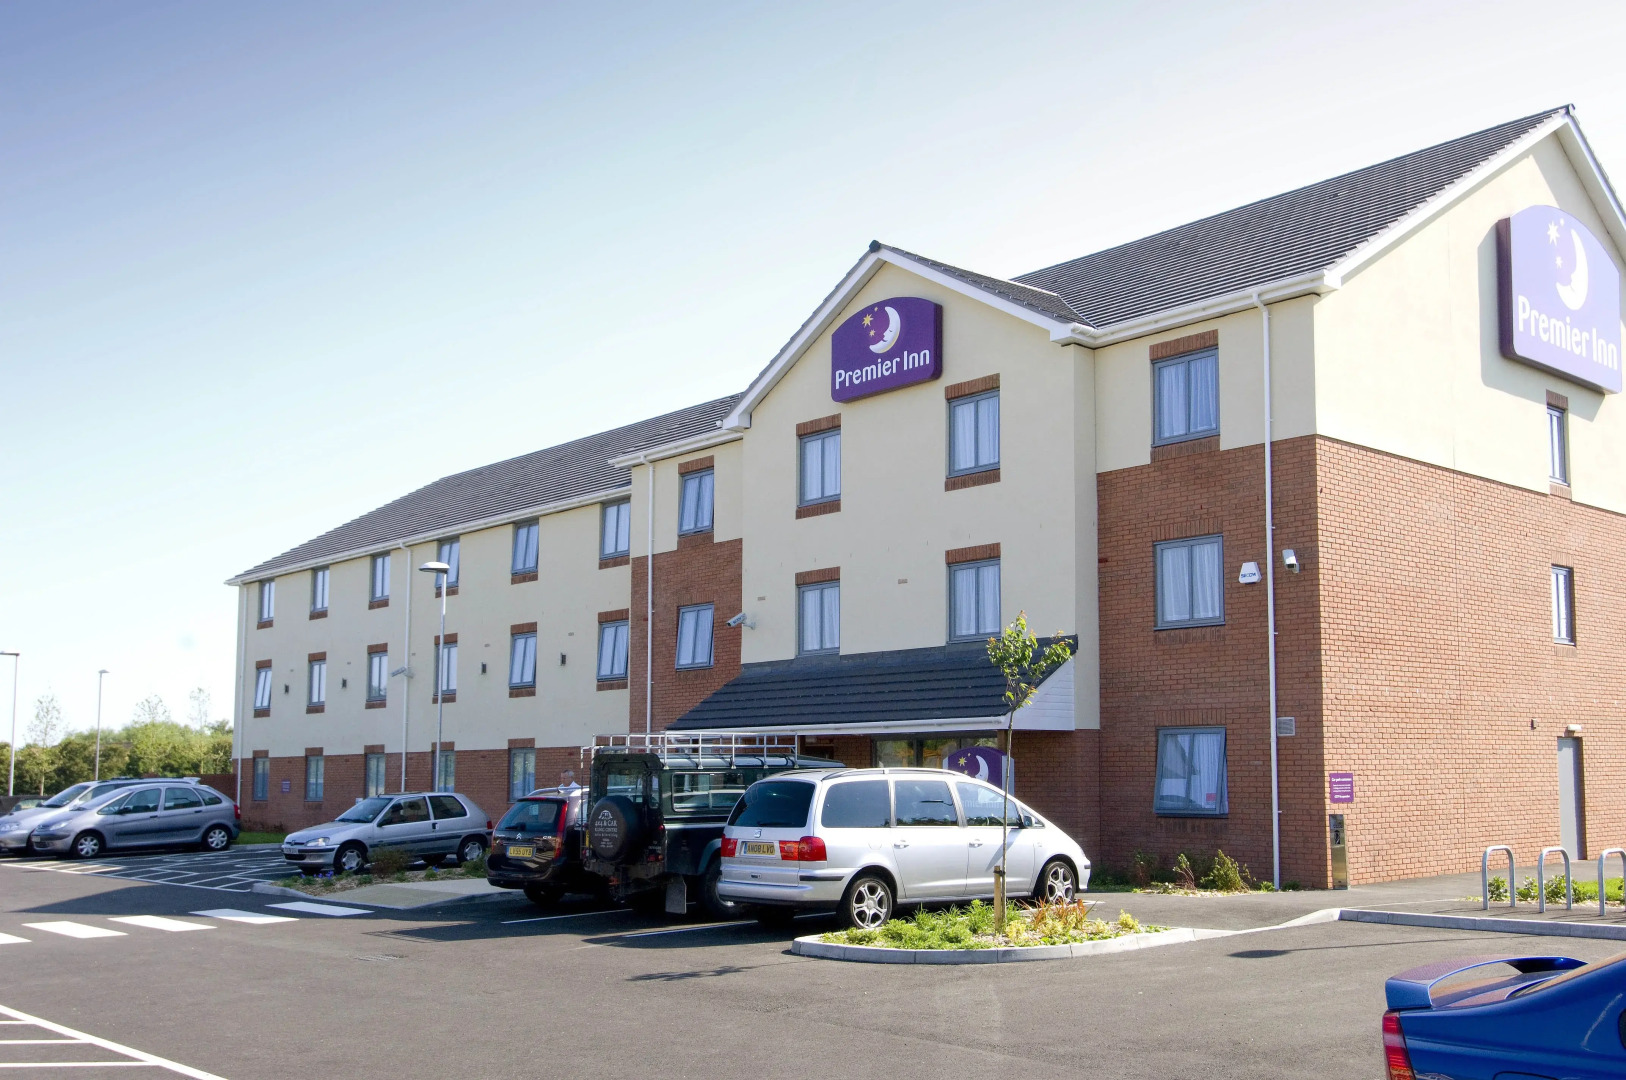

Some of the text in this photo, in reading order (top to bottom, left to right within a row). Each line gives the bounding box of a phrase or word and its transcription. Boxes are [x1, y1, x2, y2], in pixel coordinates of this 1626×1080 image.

[1518, 295, 1618, 371] Premier Inn
[835, 349, 930, 390] Premier Inn
